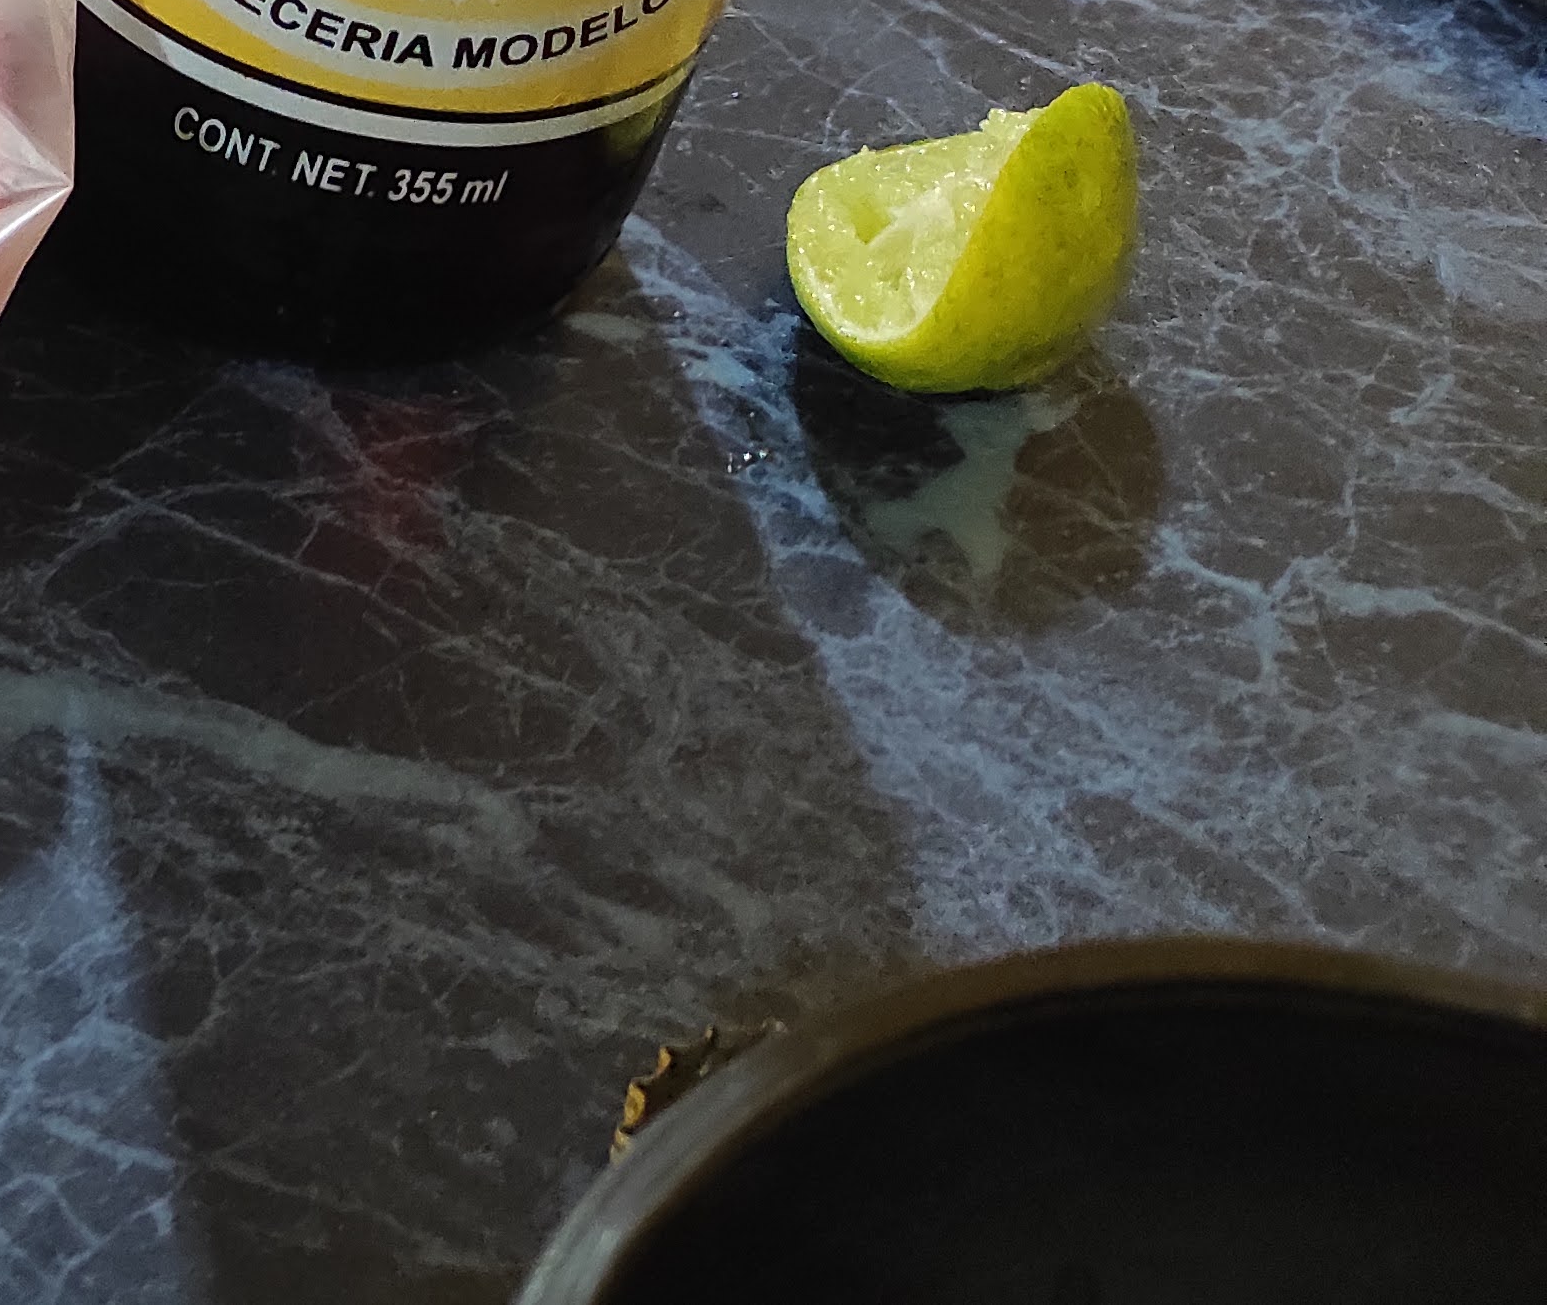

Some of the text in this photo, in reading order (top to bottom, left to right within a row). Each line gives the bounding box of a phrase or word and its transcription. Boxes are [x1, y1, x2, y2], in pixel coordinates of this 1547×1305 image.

[291, 149, 377, 197] NET.
[387, 168, 459, 206] 355
[459, 170, 509, 205] ml
